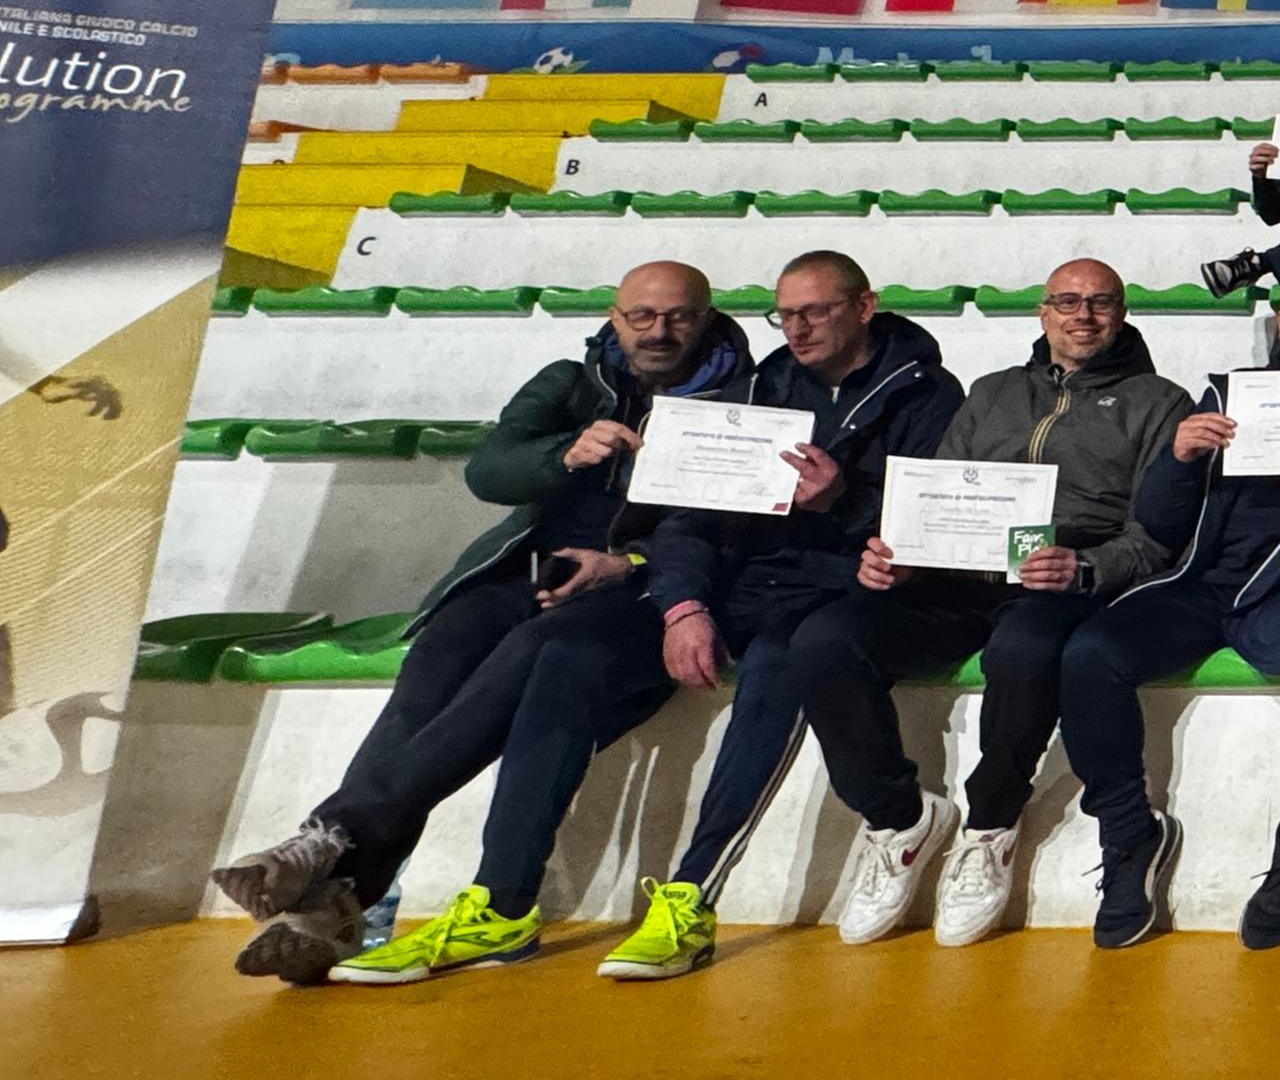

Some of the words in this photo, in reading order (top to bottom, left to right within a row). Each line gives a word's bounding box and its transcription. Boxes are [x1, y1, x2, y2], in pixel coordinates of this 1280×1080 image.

[38, 24, 50, 37] E
[52, 25, 147, 47] SCOLASTICO
[139, 20, 199, 38] CALCIO
[755, 91, 769, 108] A
[565, 160, 580, 175] B
[356, 236, 376, 256] C
[1013, 530, 1045, 545] Fair
